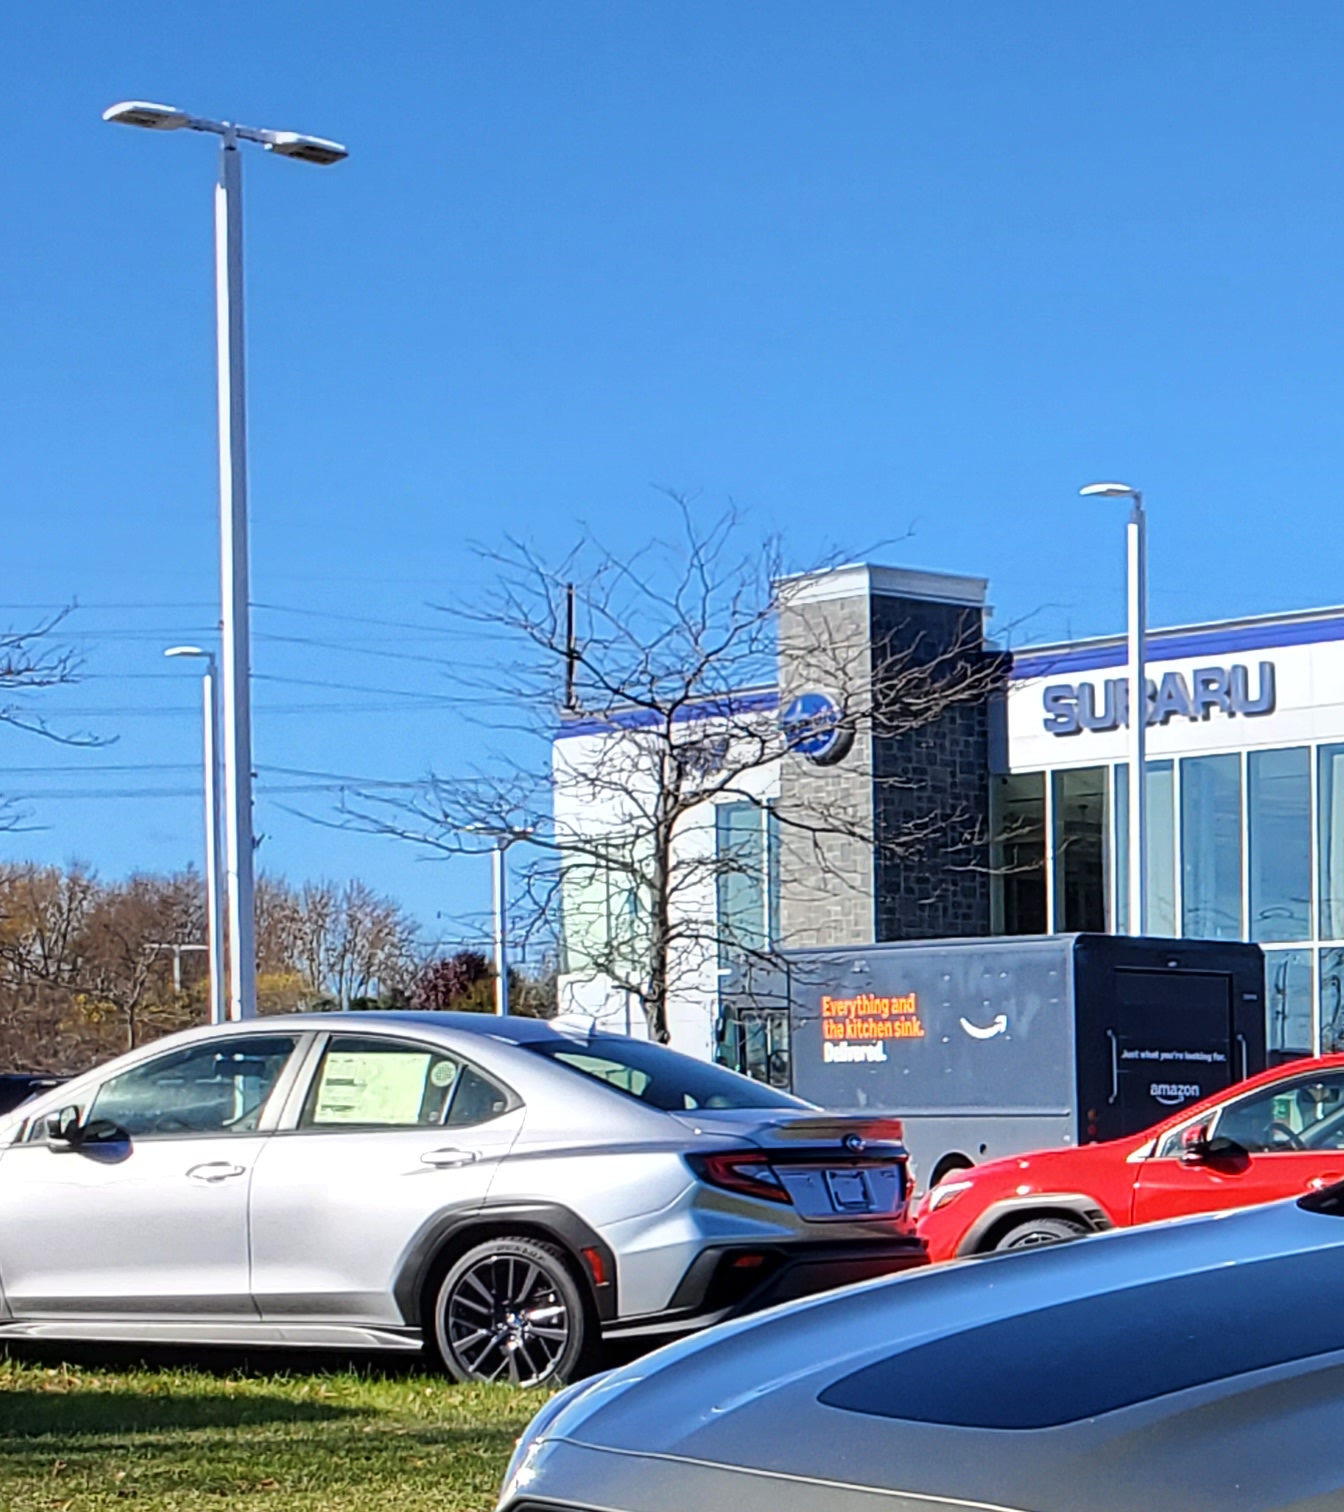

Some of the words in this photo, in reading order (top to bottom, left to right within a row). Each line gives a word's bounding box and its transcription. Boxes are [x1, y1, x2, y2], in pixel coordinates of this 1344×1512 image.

[1043, 661, 1277, 737] SUBARU
[822, 993, 890, 1018] Everything
[891, 992, 916, 1014] and
[823, 1018, 845, 1039] the
[845, 1017, 893, 1039] kitchen
[893, 1015, 925, 1038] sink.
[1150, 1083, 1200, 1098] amazon
